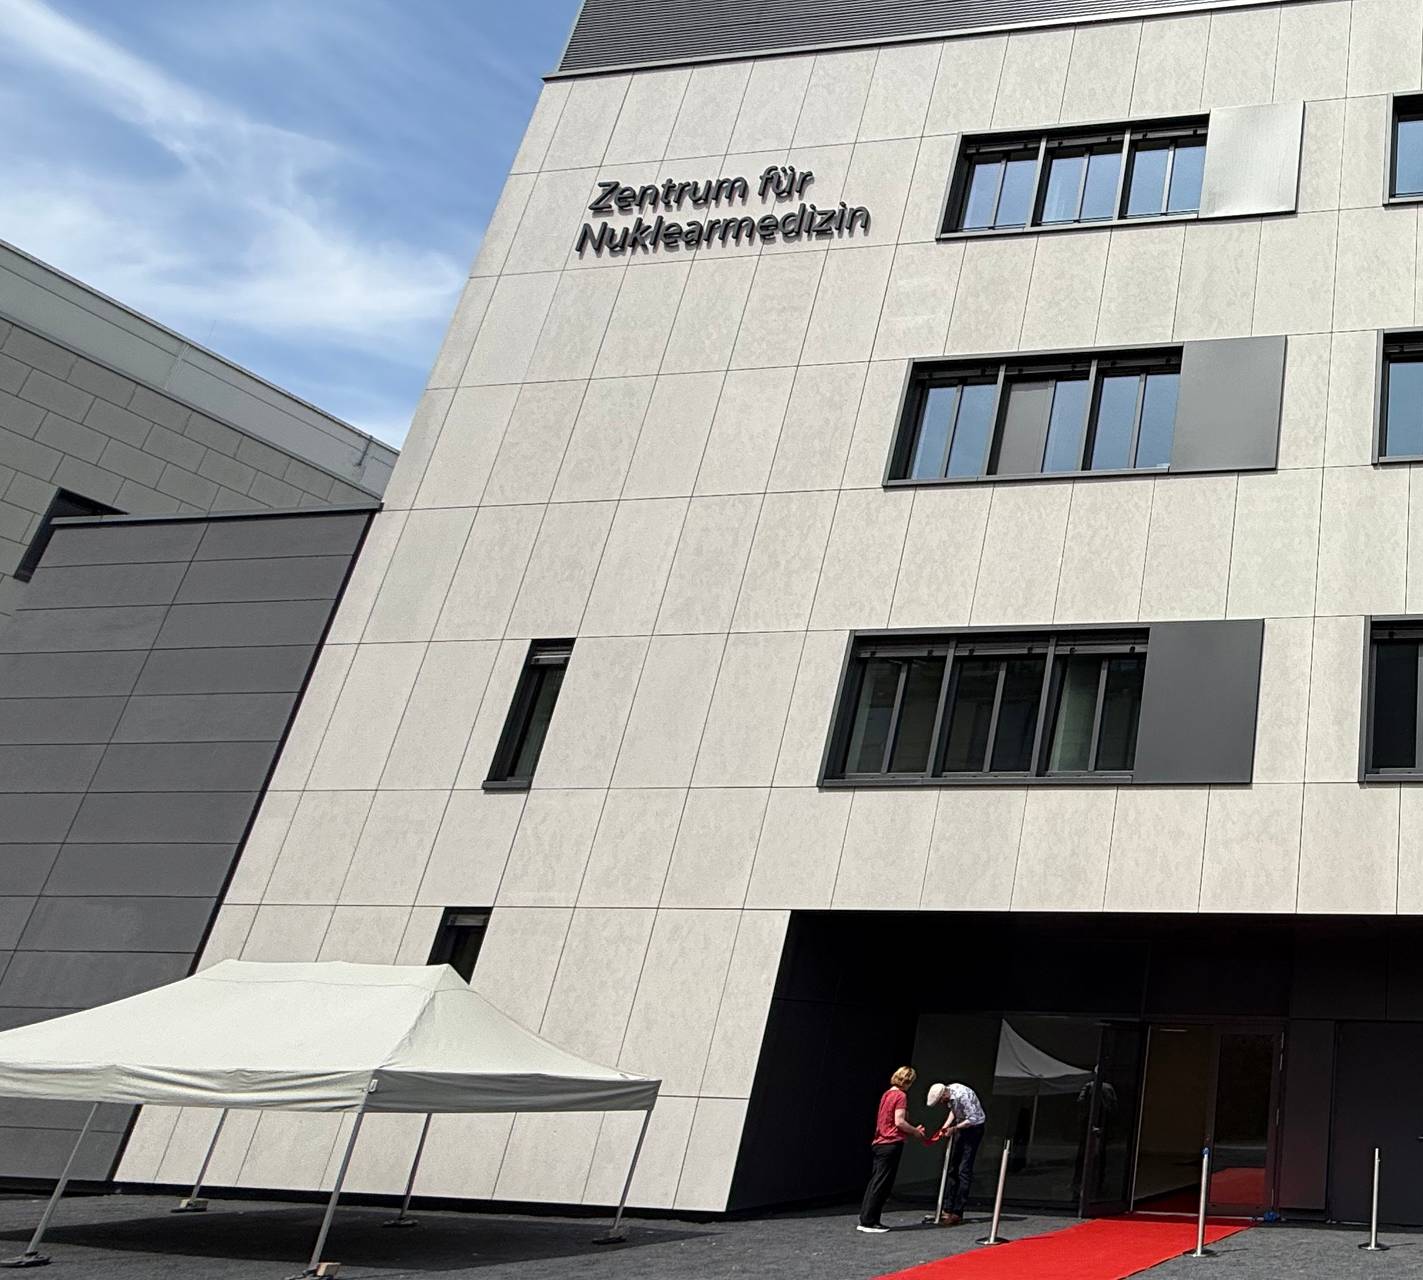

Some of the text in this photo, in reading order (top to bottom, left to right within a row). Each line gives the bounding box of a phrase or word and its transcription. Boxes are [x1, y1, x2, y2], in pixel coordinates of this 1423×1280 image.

[588, 165, 814, 213] Zentrum für
[575, 201, 872, 254] Nuklearmedizin
